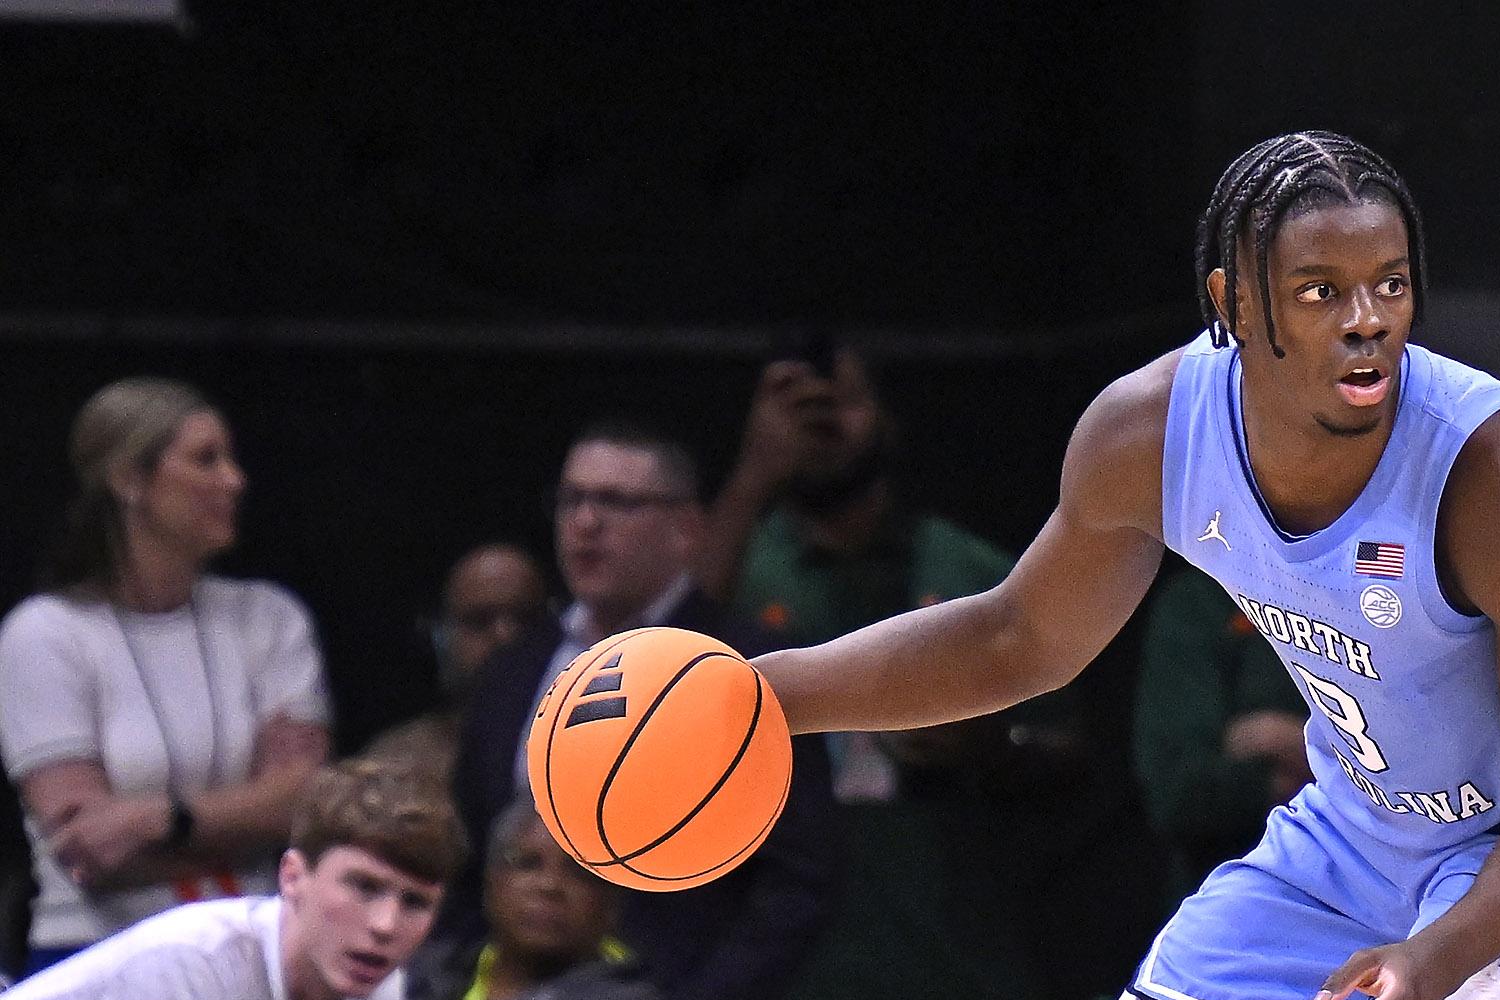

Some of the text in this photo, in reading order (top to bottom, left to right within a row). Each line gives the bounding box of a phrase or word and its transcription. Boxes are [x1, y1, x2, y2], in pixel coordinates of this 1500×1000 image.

[1238, 593, 1381, 681] NORTH
[1367, 599, 1398, 611] ACC
[1331, 743, 1496, 824] ROLINA
